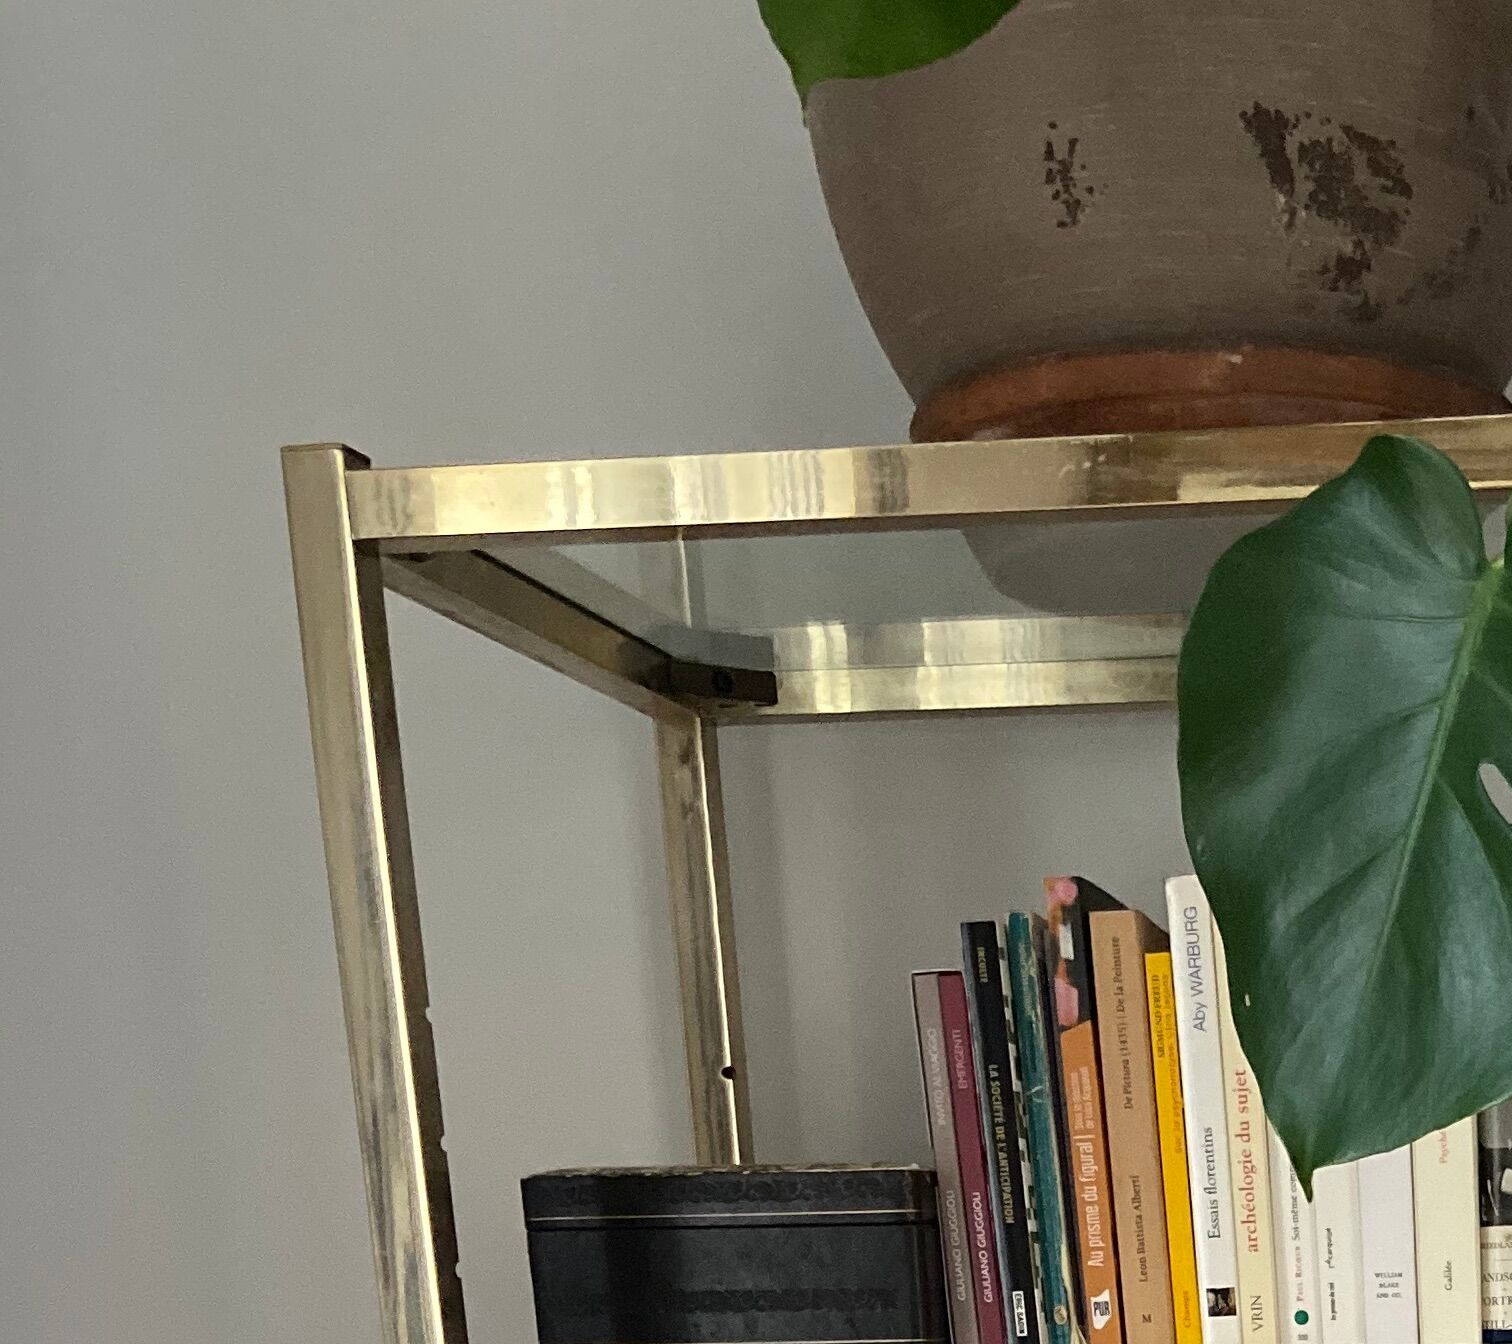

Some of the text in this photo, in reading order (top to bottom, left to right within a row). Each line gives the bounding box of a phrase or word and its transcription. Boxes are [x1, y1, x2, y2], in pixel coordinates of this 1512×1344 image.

[1182, 905, 1208, 1033] Aby WARBURG
[1198, 1125, 1221, 1239] Essais florentins
[1230, 1068, 1263, 1253] archéologie du sujet
[1249, 1293, 1264, 1333] VRIN
